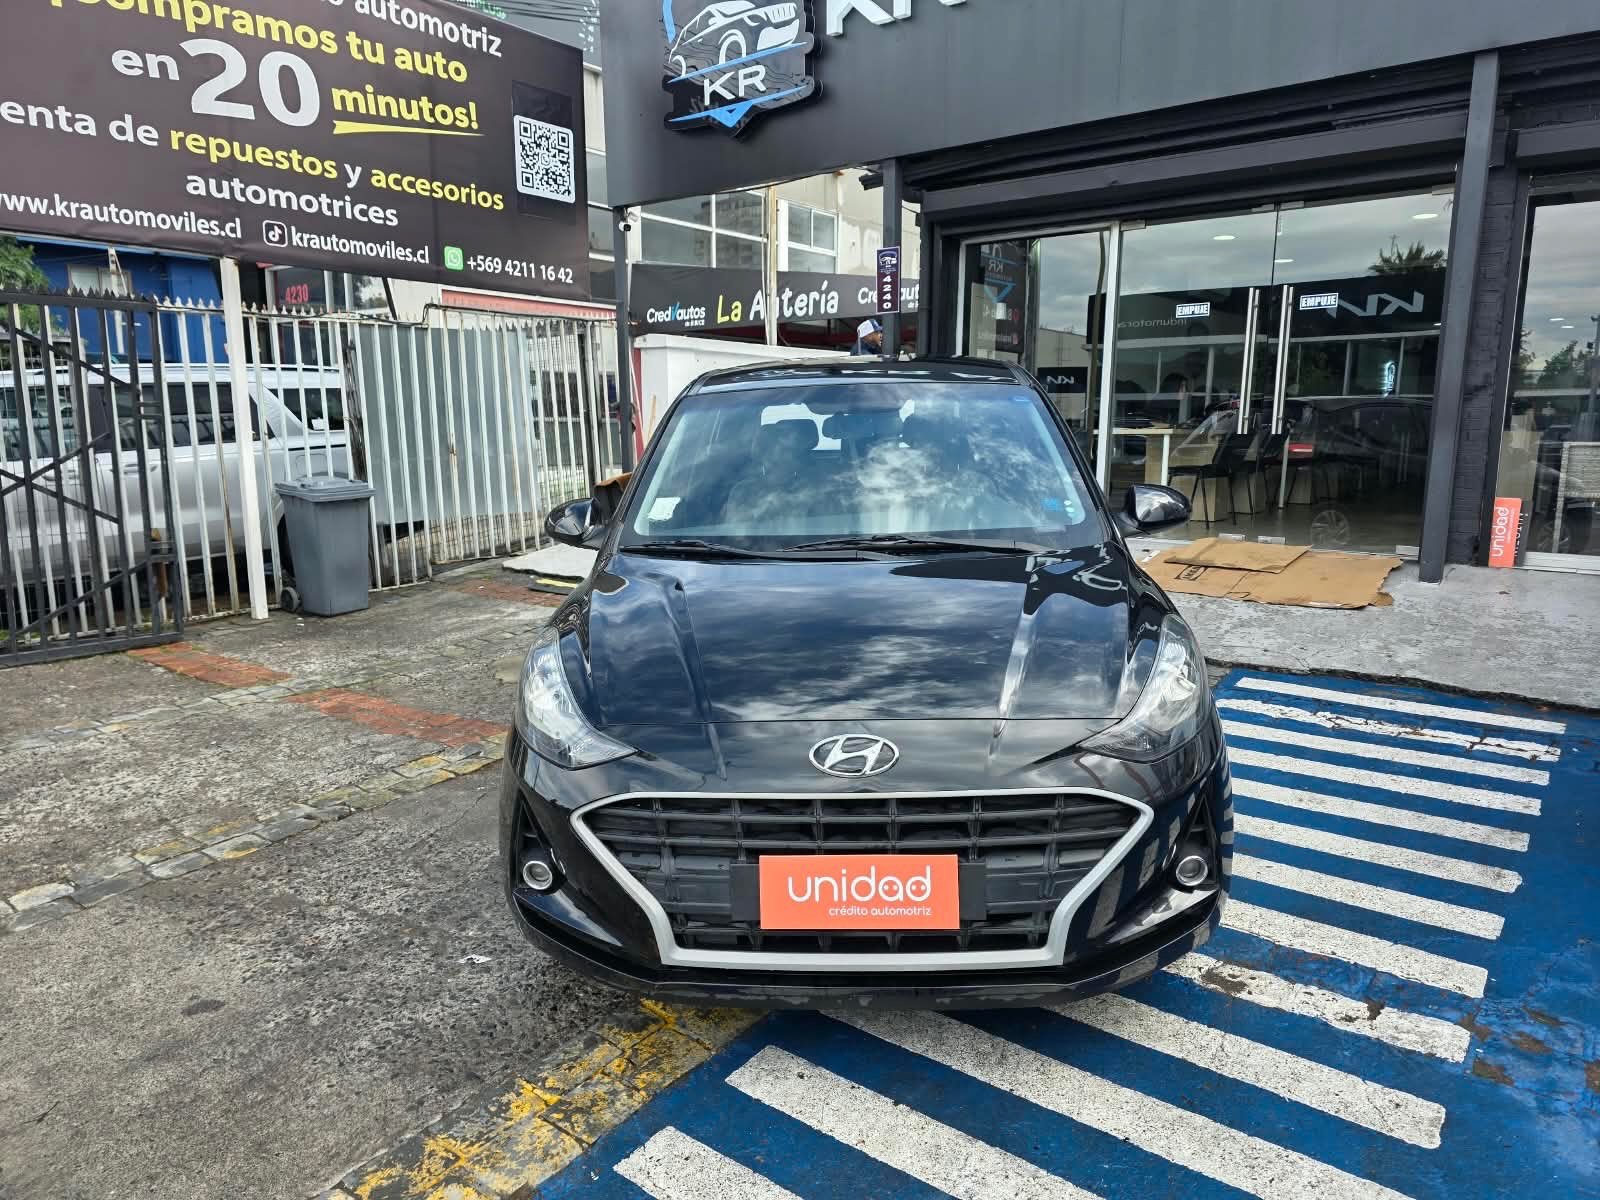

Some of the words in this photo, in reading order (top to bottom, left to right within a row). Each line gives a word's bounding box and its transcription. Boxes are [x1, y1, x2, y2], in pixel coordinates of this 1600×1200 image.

[355, 0, 502, 57] automotriz
[345, 31, 385, 65] tu
[394, 47, 468, 83] auto
[111, 49, 180, 81] en
[179, 38, 320, 127] 20
[331, 84, 479, 130] minutos!
[704, 64, 767, 106] KR
[108, 114, 160, 147] de
[170, 129, 338, 180] repuestos
[344, 163, 362, 188] y
[371, 168, 505, 210] accesorios
[186, 174, 399, 227] automotrices
[0, 191, 242, 239] ww.krautomoviles.cl
[291, 226, 430, 264] krautomoviles.cl
[467, 254, 503, 274] +569
[504, 259, 536, 279] 4211
[717, 294, 742, 324] La
[1177, 304, 1209, 317] EMPUJE
[1301, 294, 1337, 309] EMPUJE
[1491, 506, 1510, 557] unidad
[788, 865, 932, 902] unidad
[828, 905, 869, 917] crédito
[871, 905, 932, 917] automotriz
